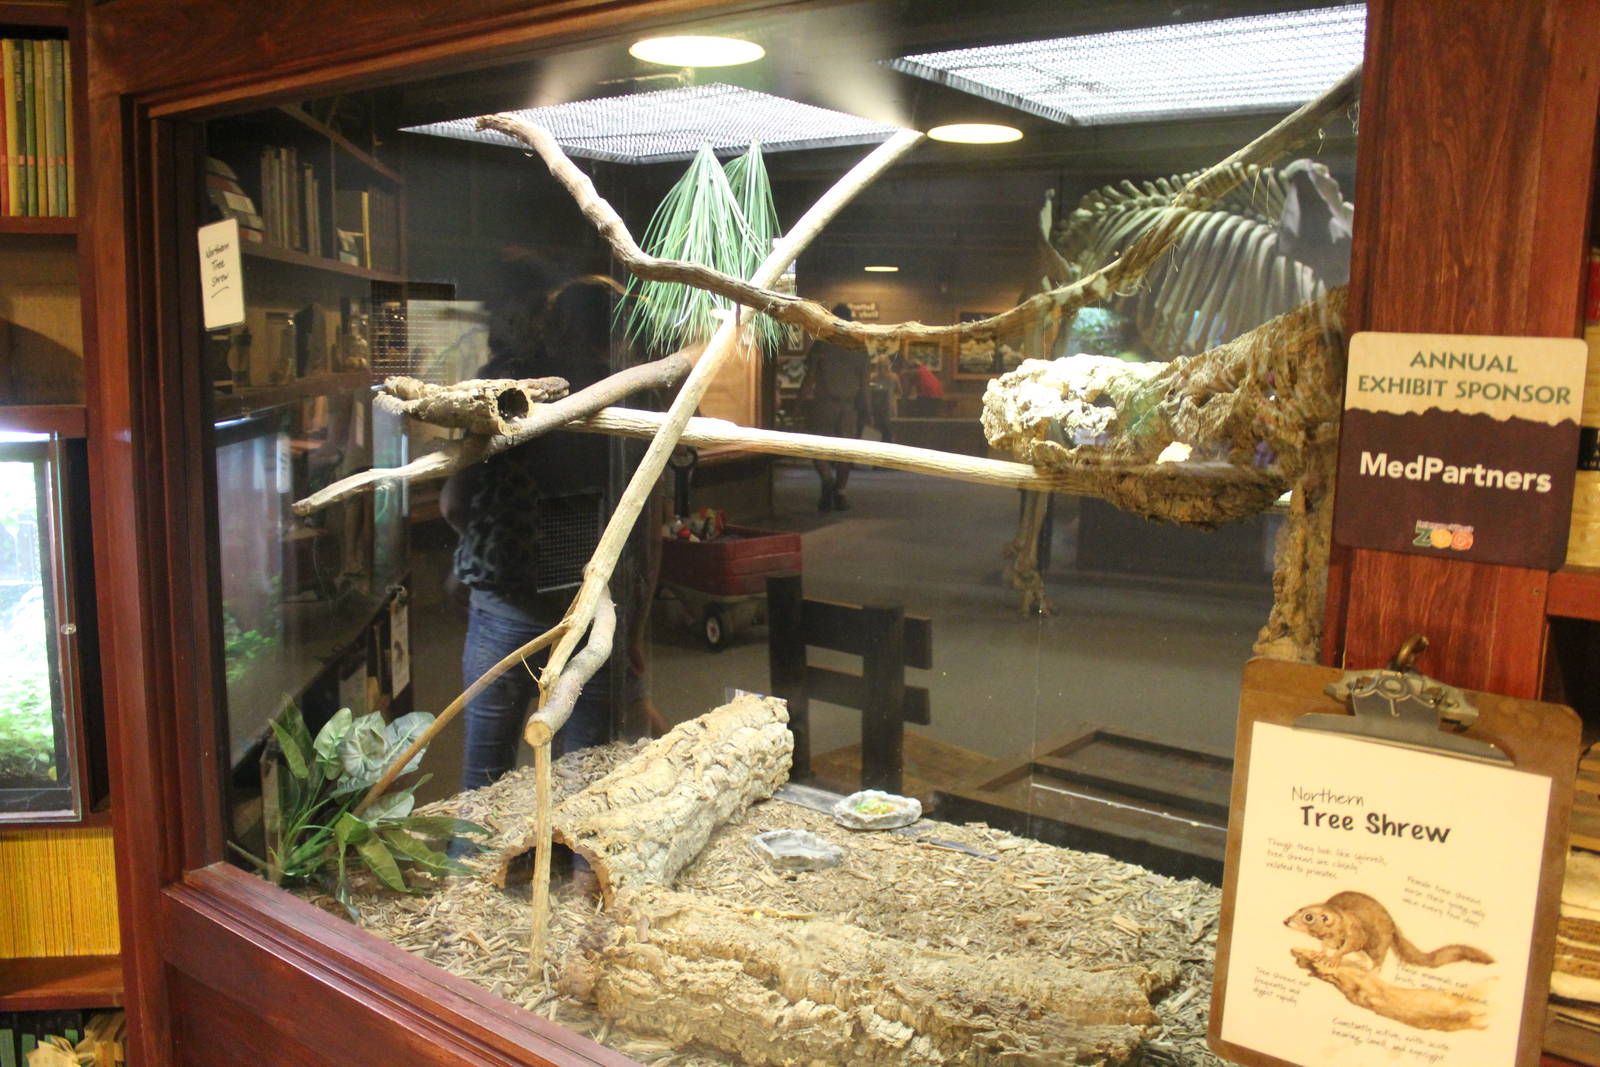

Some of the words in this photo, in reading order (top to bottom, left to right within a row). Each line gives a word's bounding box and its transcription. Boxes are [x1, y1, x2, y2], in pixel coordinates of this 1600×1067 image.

[211, 259, 225, 270] Tree
[1410, 351, 1518, 373] ANNUAL
[1358, 375, 1447, 396] EXHIBIT
[1456, 381, 1570, 405] SPONSOR
[1360, 452, 1551, 493] MedPartners
[1292, 785, 1364, 807] Northern
[1300, 805, 1354, 830] Tree
[1366, 812, 1451, 843] Shrew
